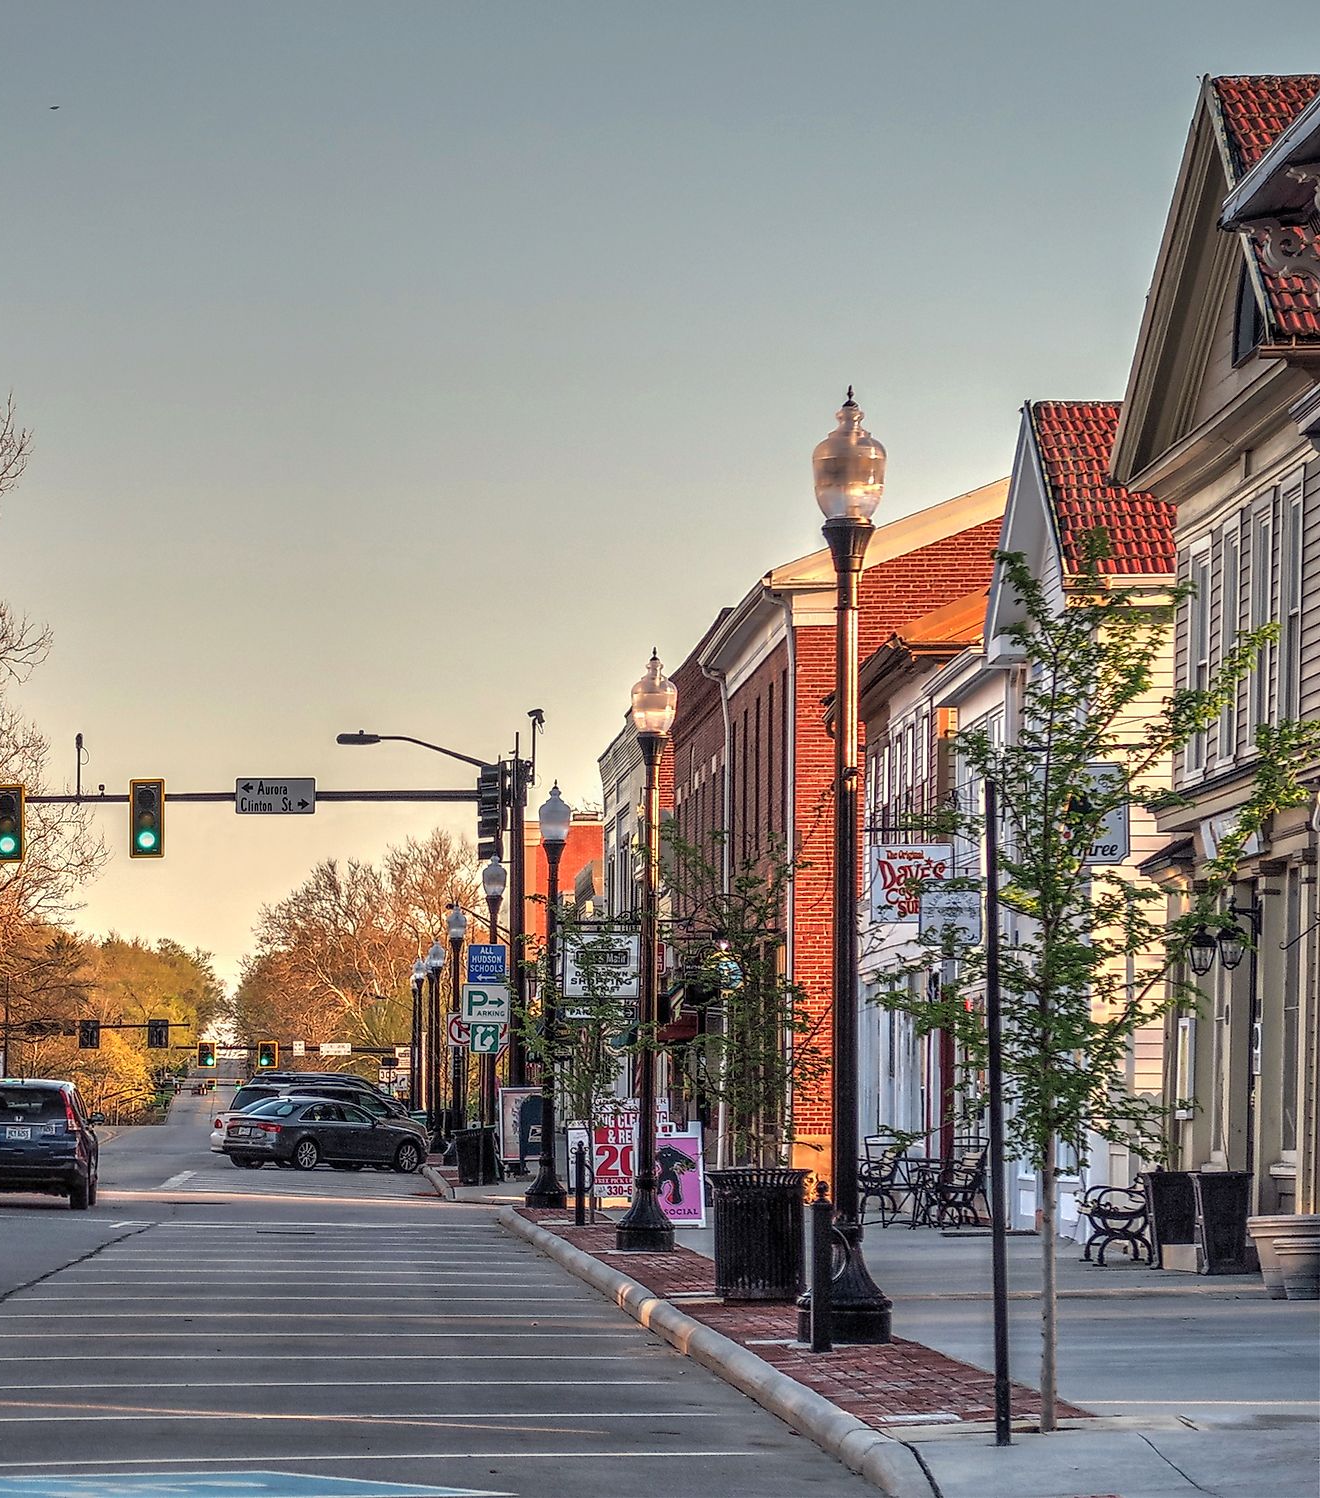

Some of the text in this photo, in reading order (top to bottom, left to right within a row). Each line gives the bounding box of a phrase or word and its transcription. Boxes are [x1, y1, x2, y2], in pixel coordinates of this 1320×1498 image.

[257, 781, 288, 795] Aurora
[241, 797, 293, 811] Clinton St.
[899, 850, 924, 860] Original
[608, 1130, 616, 1143] &
